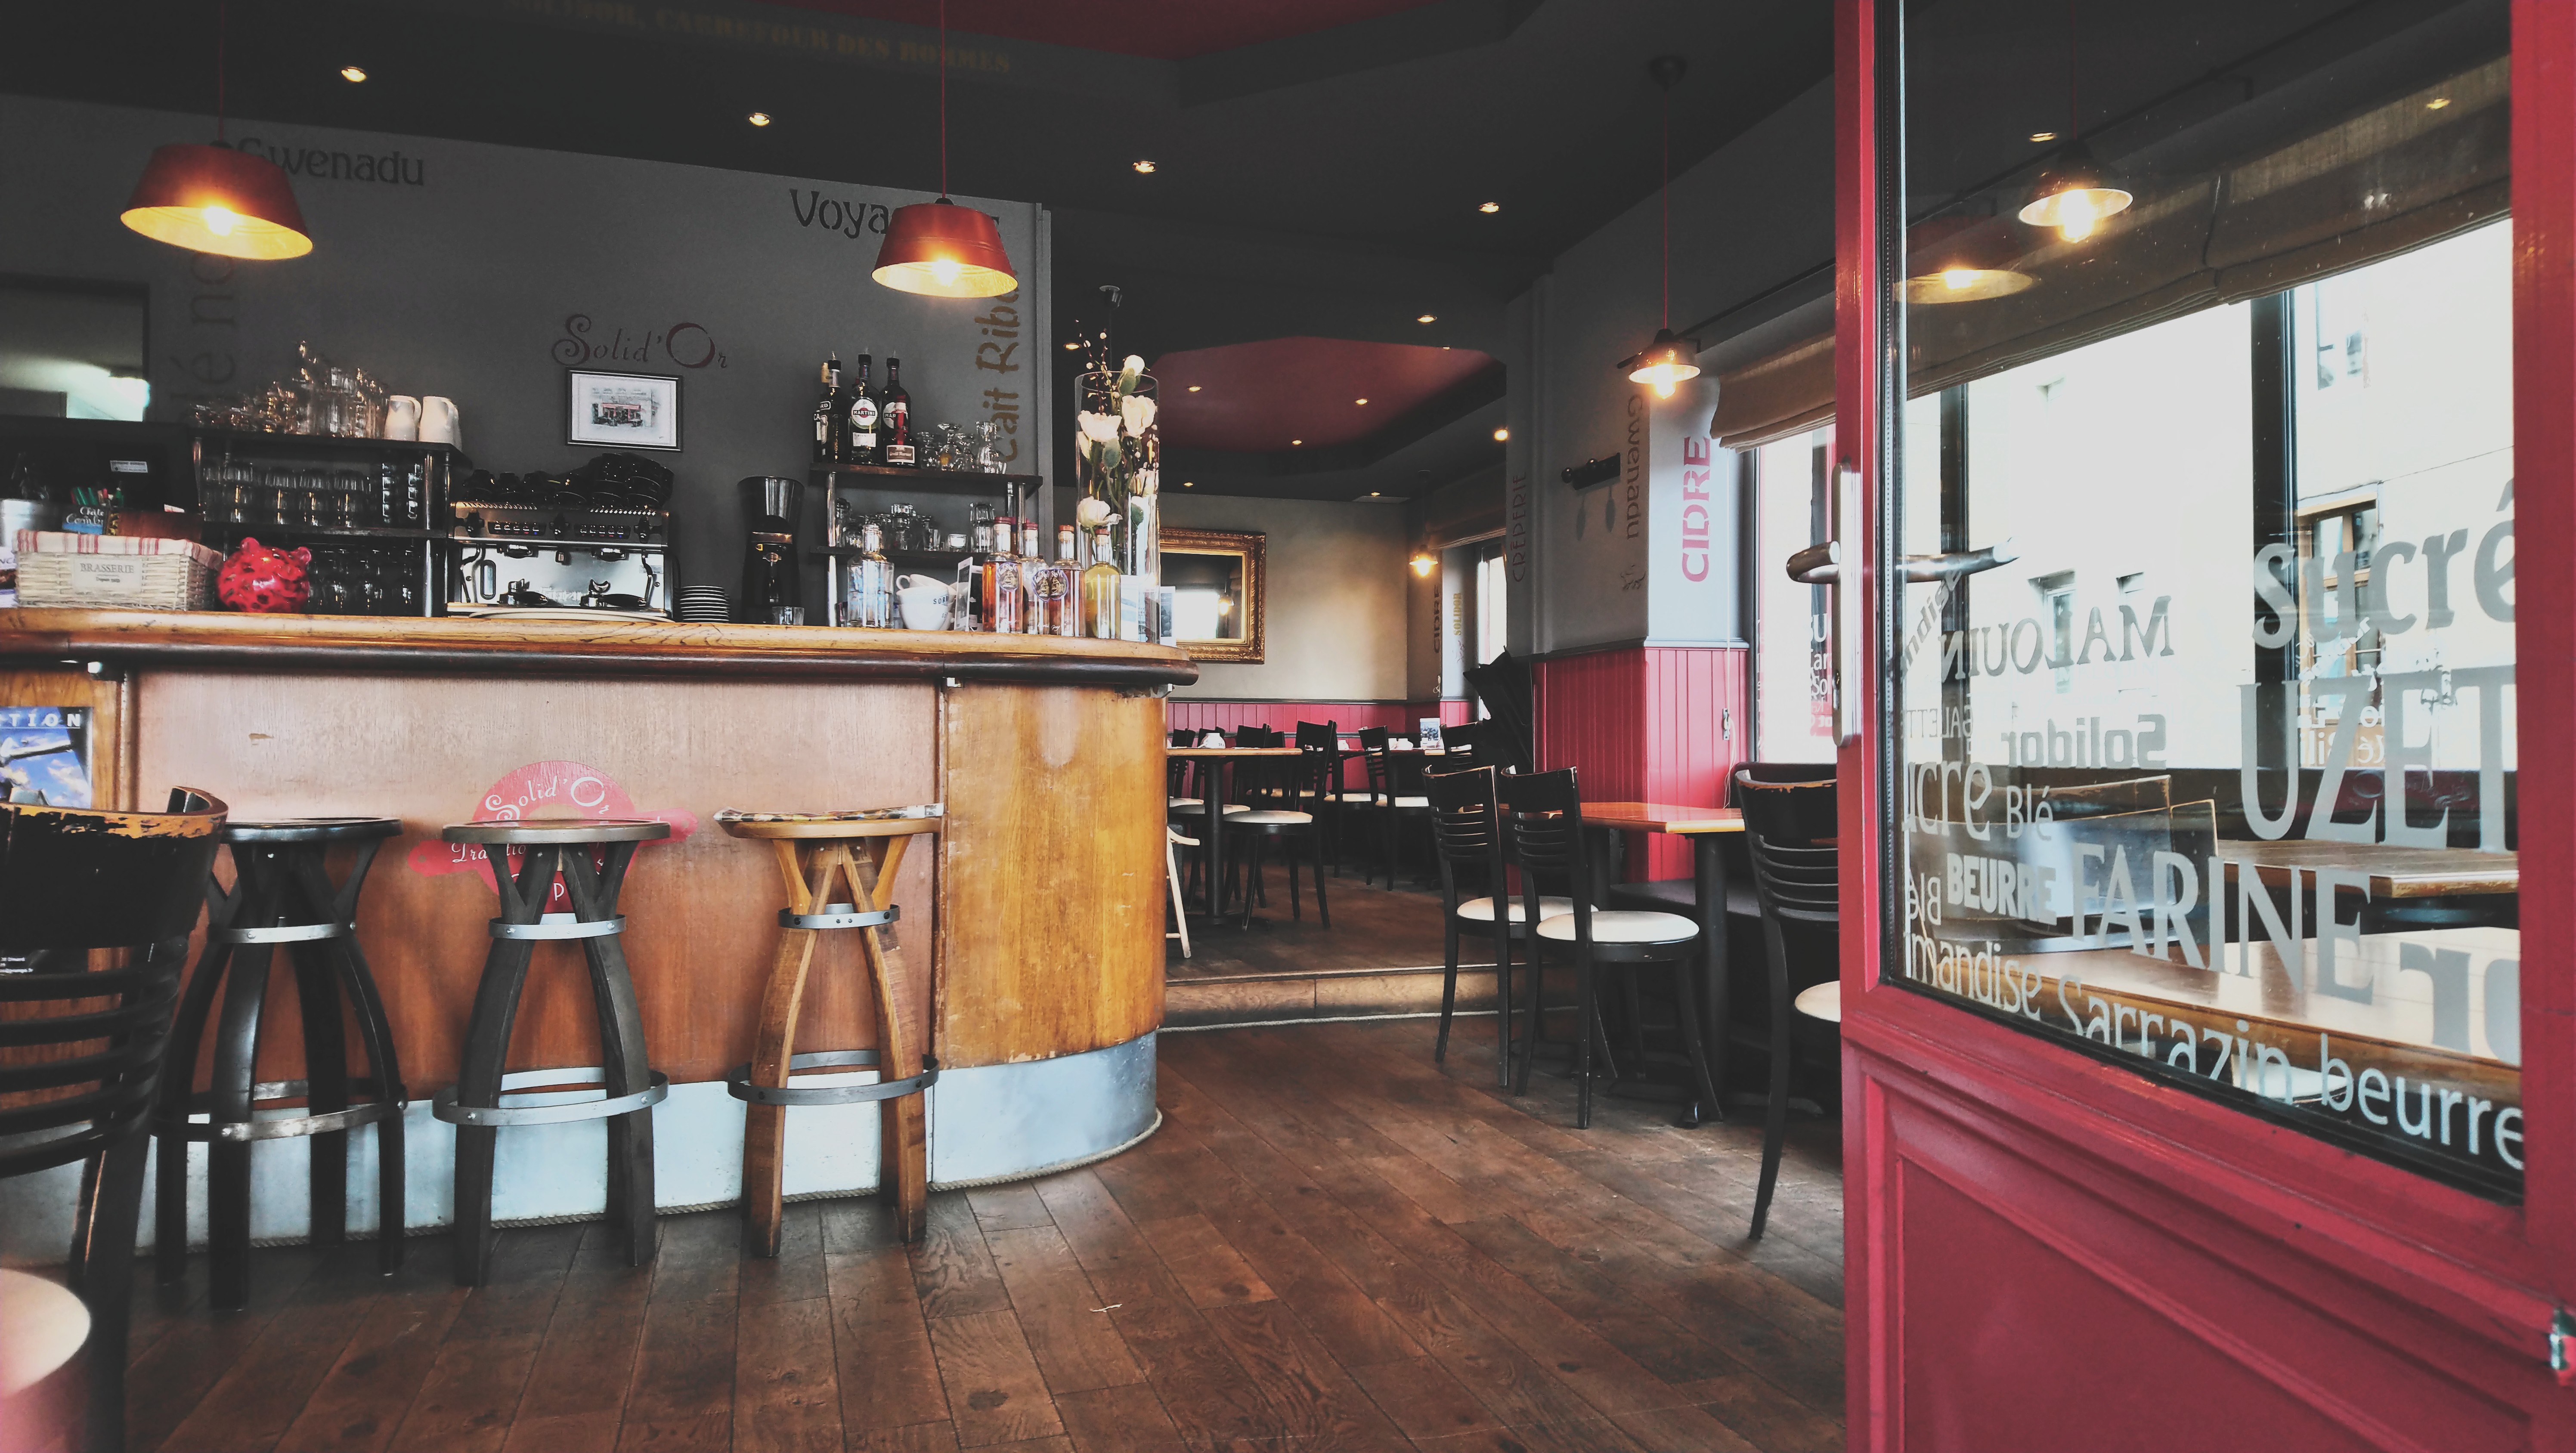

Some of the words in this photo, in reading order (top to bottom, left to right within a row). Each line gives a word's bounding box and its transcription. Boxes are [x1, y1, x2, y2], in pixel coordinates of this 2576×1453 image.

[838, 34, 890, 59] DES
[1682, 436, 1710, 582] CIDRE
[80, 563, 134, 573] BRASSERIE
[1453, 592, 1462, 636] SOLIDOR
[1, 713, 80, 727] TION
[2006, 783, 2053, 841] Blé
[1947, 853, 2057, 925] BEURRE
[2070, 843, 2374, 1005] FARINE
[1903, 932, 2042, 1021] mandise
[2058, 974, 2294, 1105] Sarrazin
